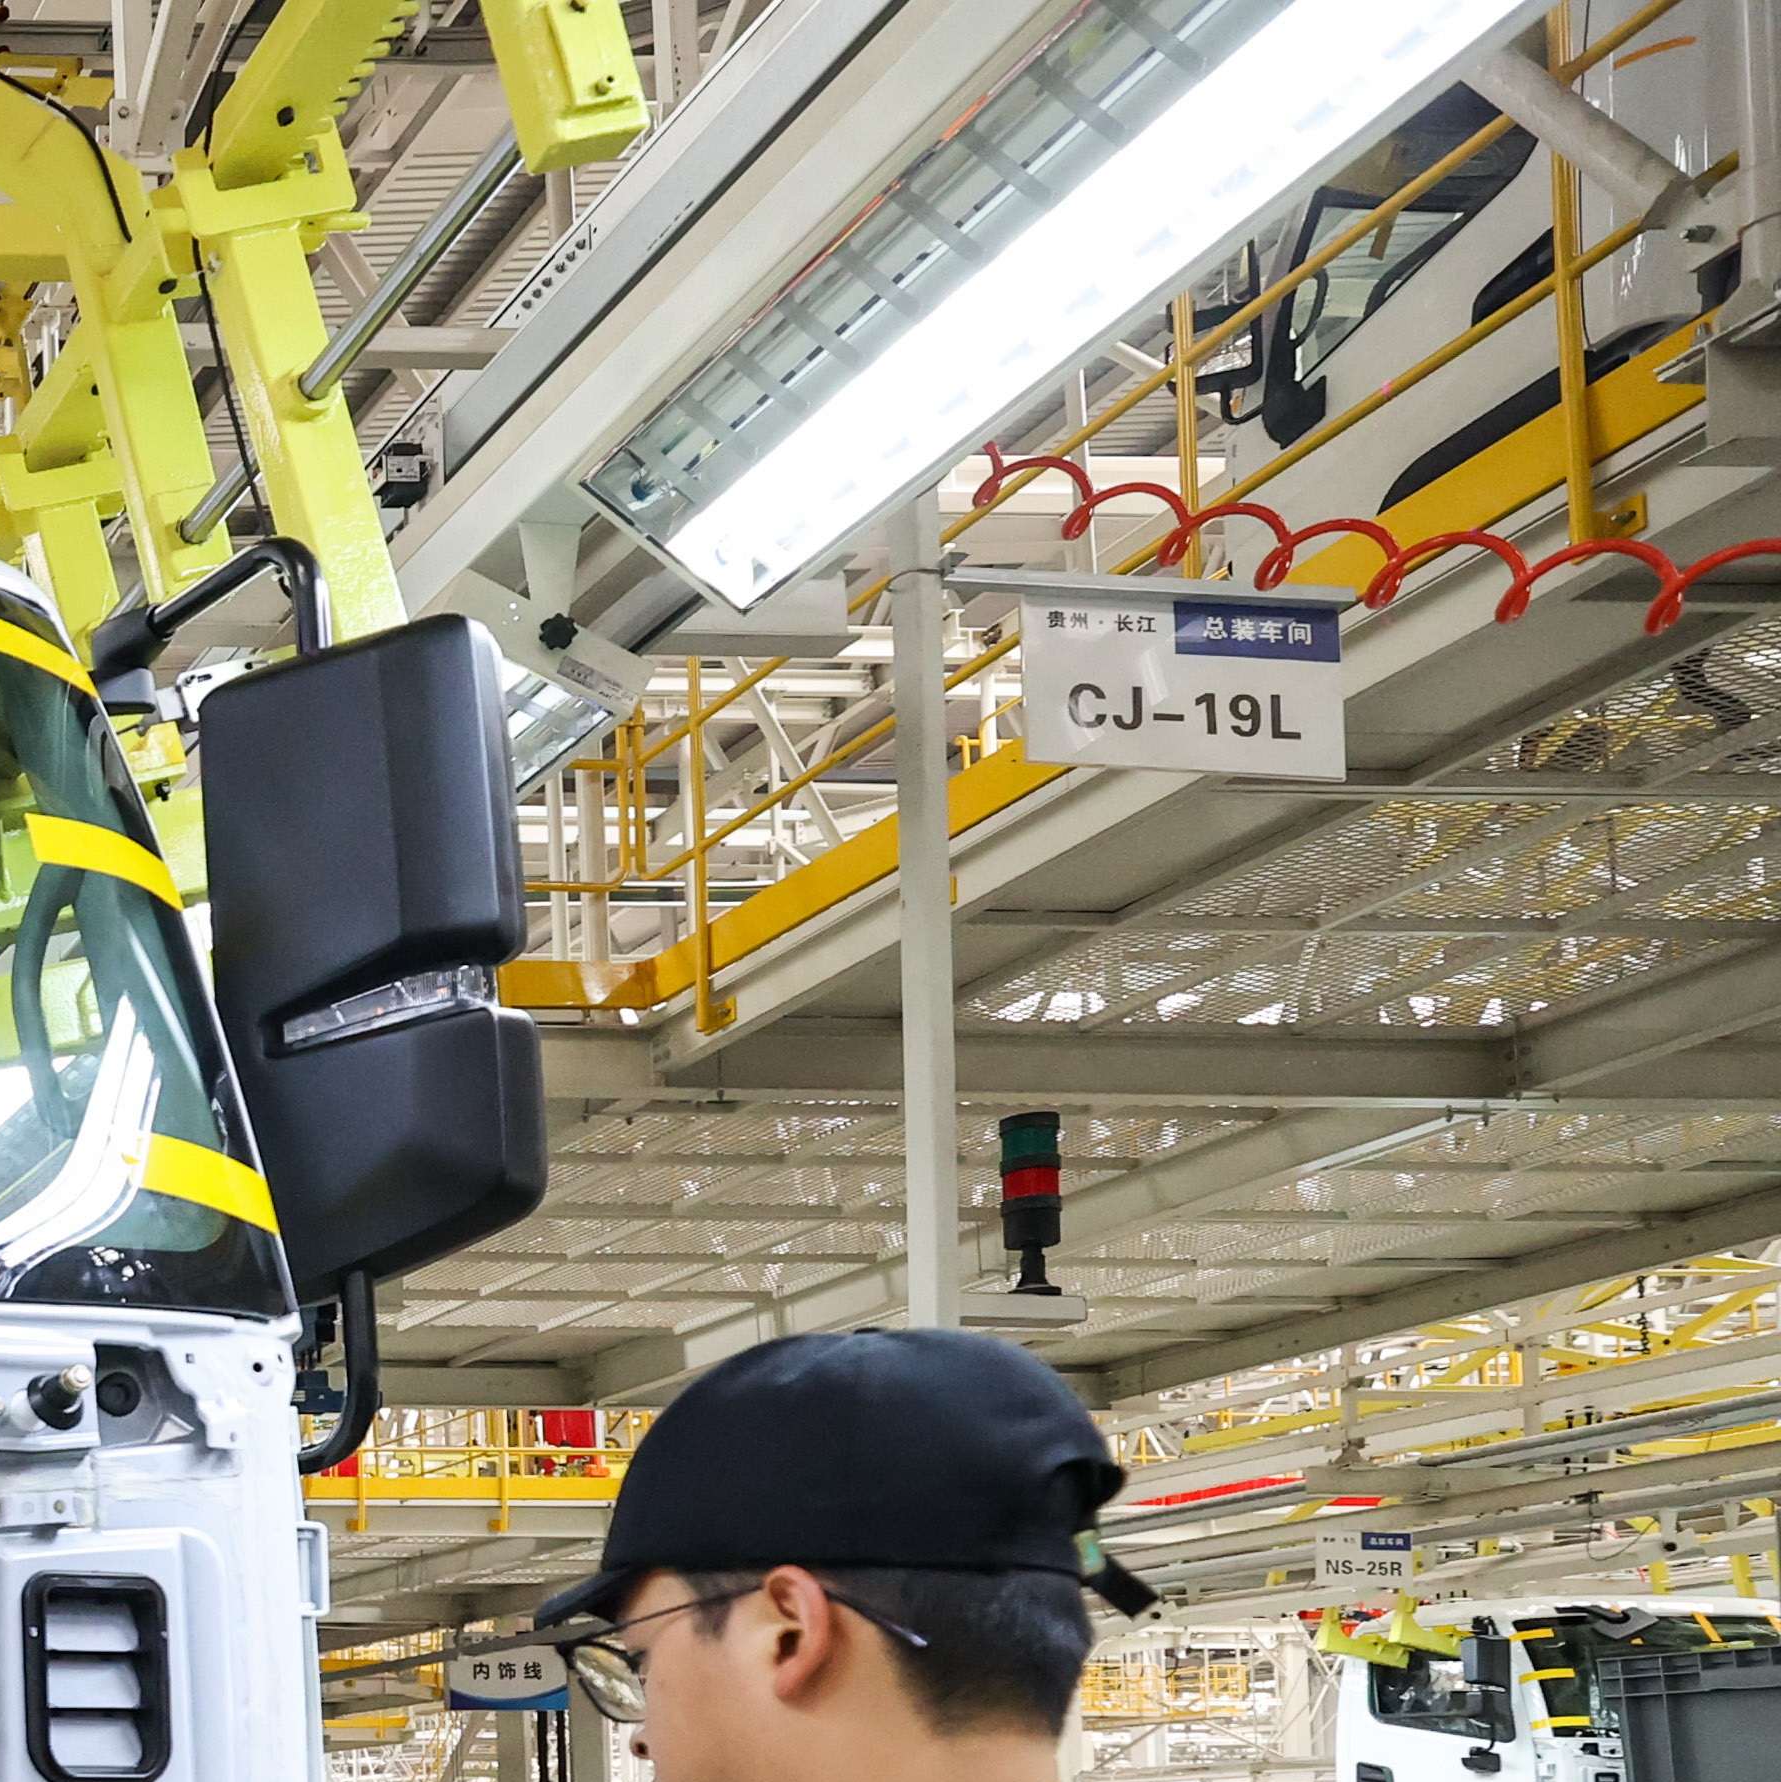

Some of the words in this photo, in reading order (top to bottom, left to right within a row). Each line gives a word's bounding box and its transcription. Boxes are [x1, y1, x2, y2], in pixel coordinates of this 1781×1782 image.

[1202, 615, 1313, 646] 总装车间
[1068, 683, 1302, 740] CJ-19L
[1325, 1559, 1403, 1577] NS-25R
[473, 1661, 543, 1681] 内饰线
